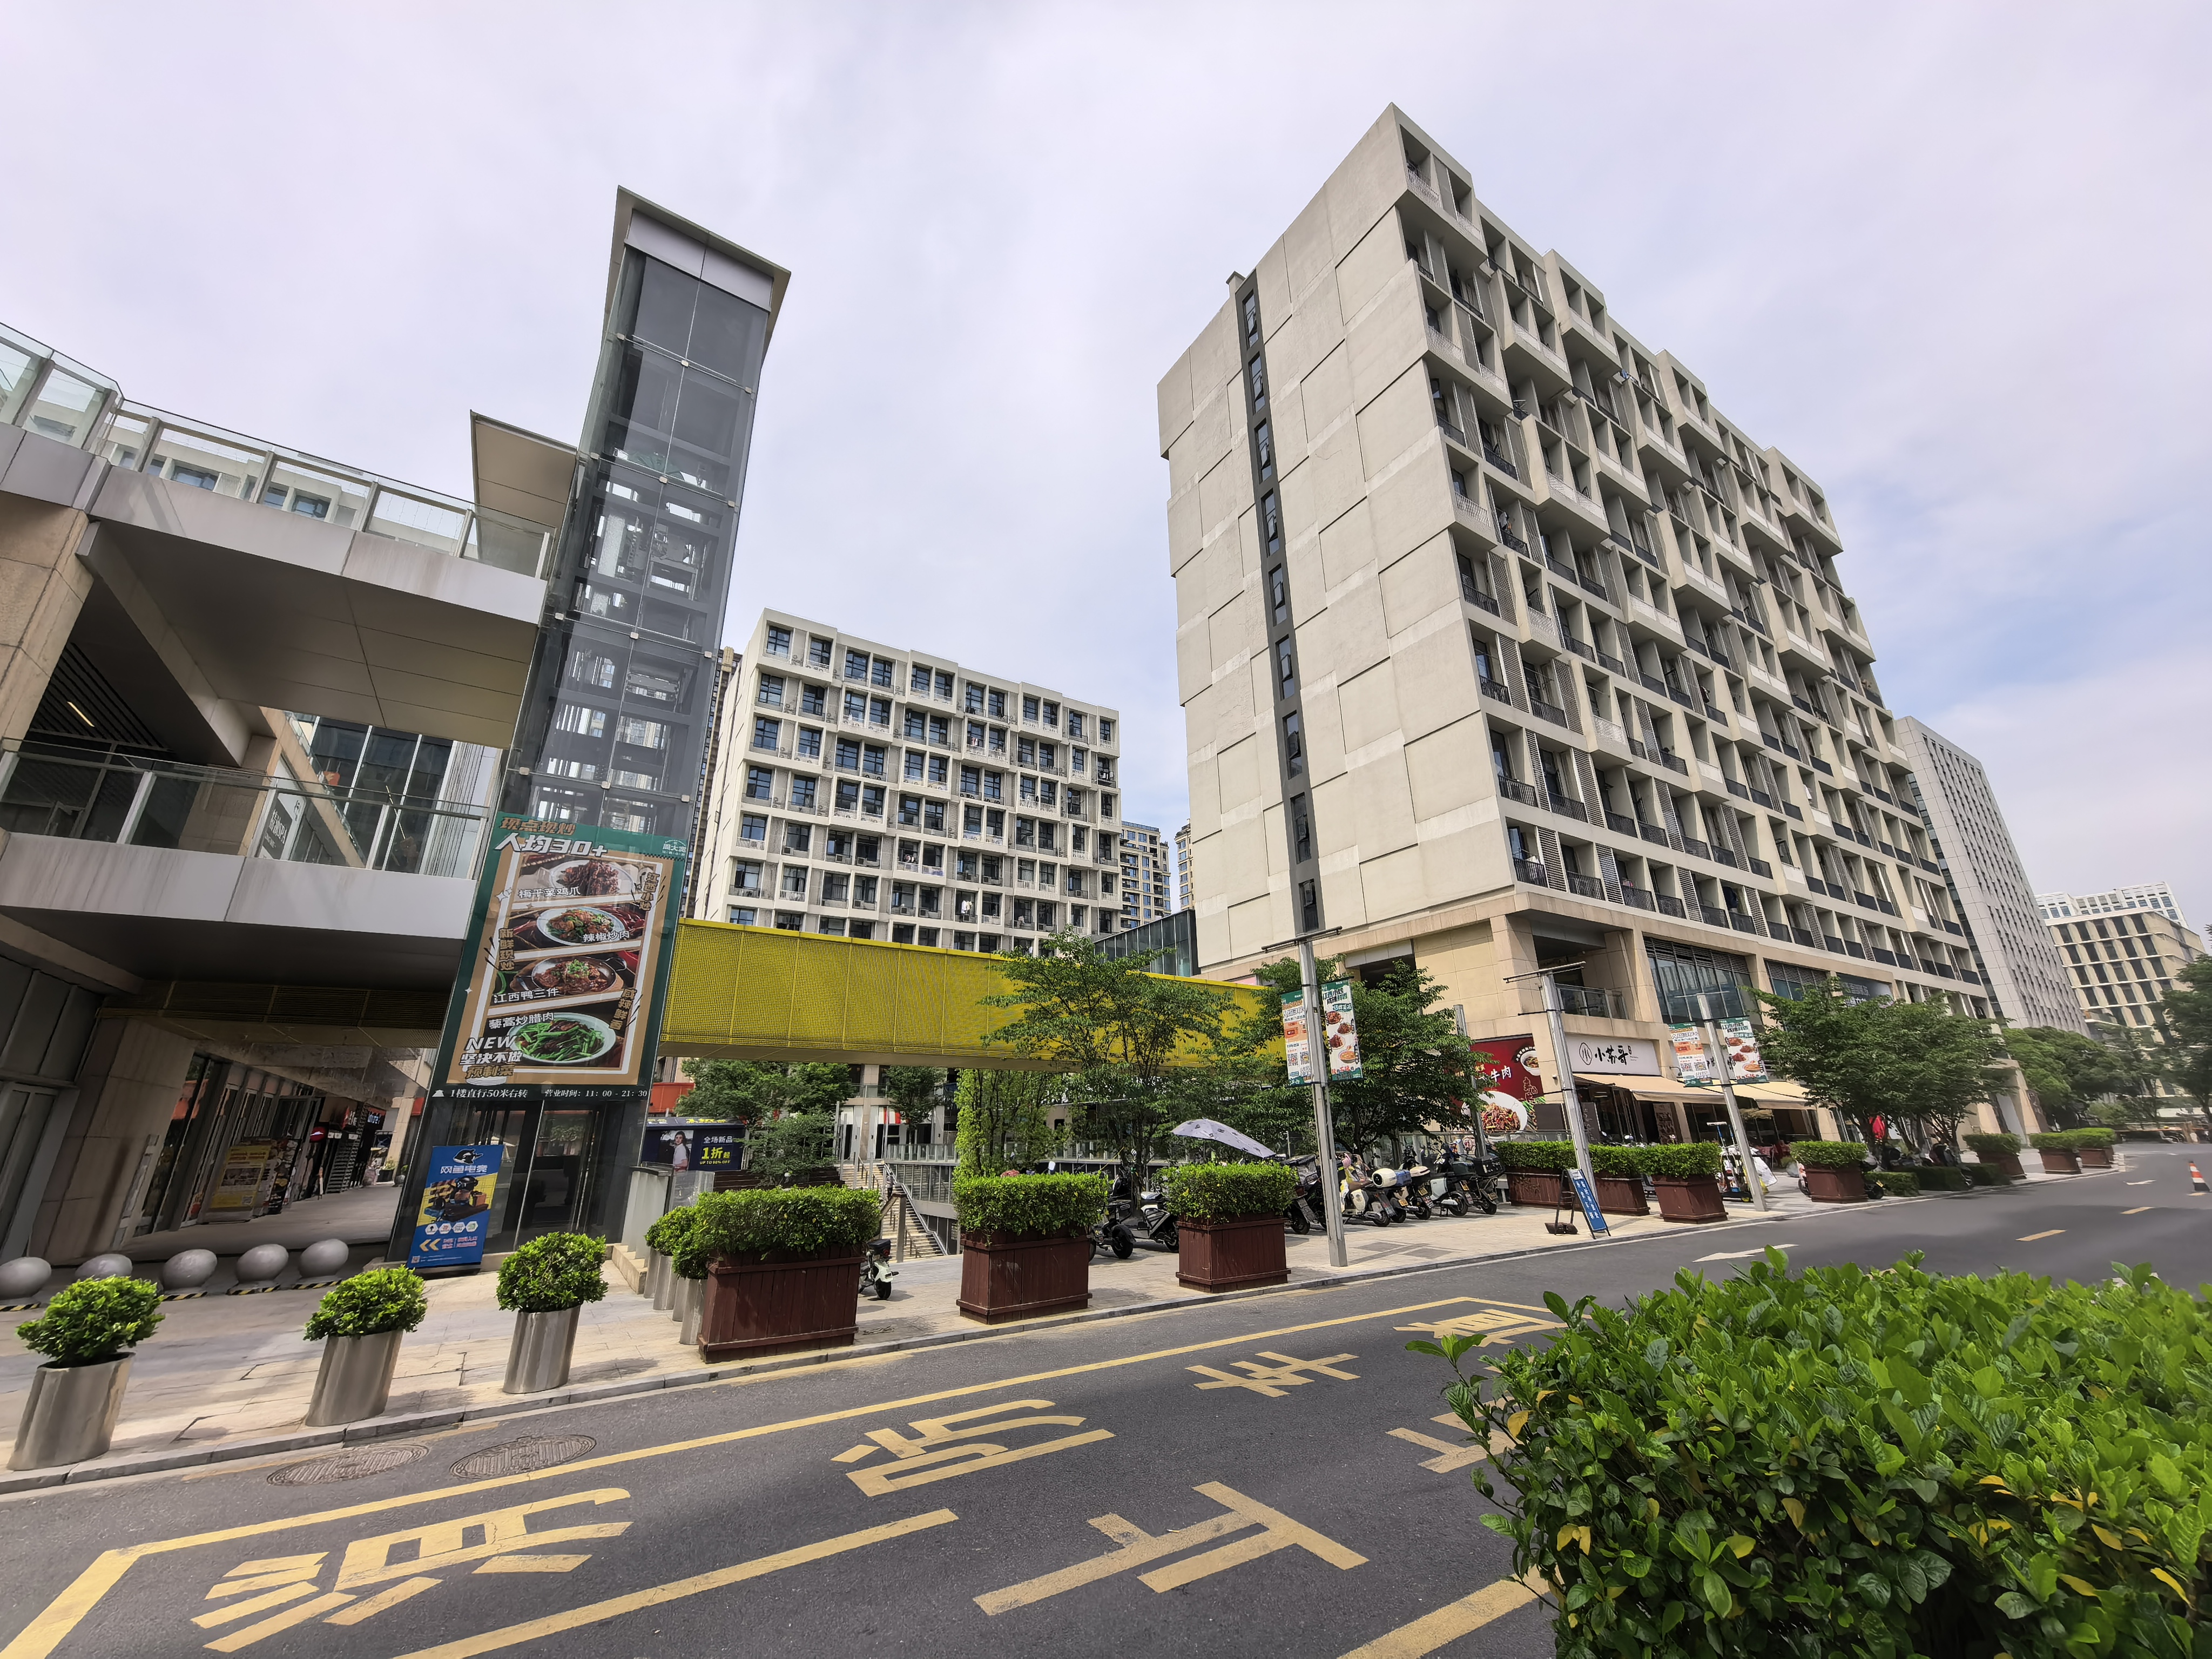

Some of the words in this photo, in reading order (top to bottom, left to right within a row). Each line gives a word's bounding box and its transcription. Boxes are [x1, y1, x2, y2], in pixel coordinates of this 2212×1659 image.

[500, 818, 576, 835] 现点现炒
[495, 833, 608, 857] 人均30+
[519, 886, 581, 899] 梅干菜鸡爪
[639, 872, 660, 911] 江西小炒
[582, 929, 630, 942] 辣椒炒肉
[498, 928, 515, 971] 新鲜现炒
[494, 987, 559, 1004] 江西鸭三件
[488, 1012, 555, 1029] 藜蒿炒腊肉
[465, 1036, 517, 1051] NEW
[459, 1050, 524, 1066] 坚决不做
[465, 1067, 514, 1079] 预制菜
[450, 1088, 528, 1099] 1楼直行50米右转
[704, 1136, 733, 1144] 全场新品
[702, 1146, 731, 1159] 1折起
